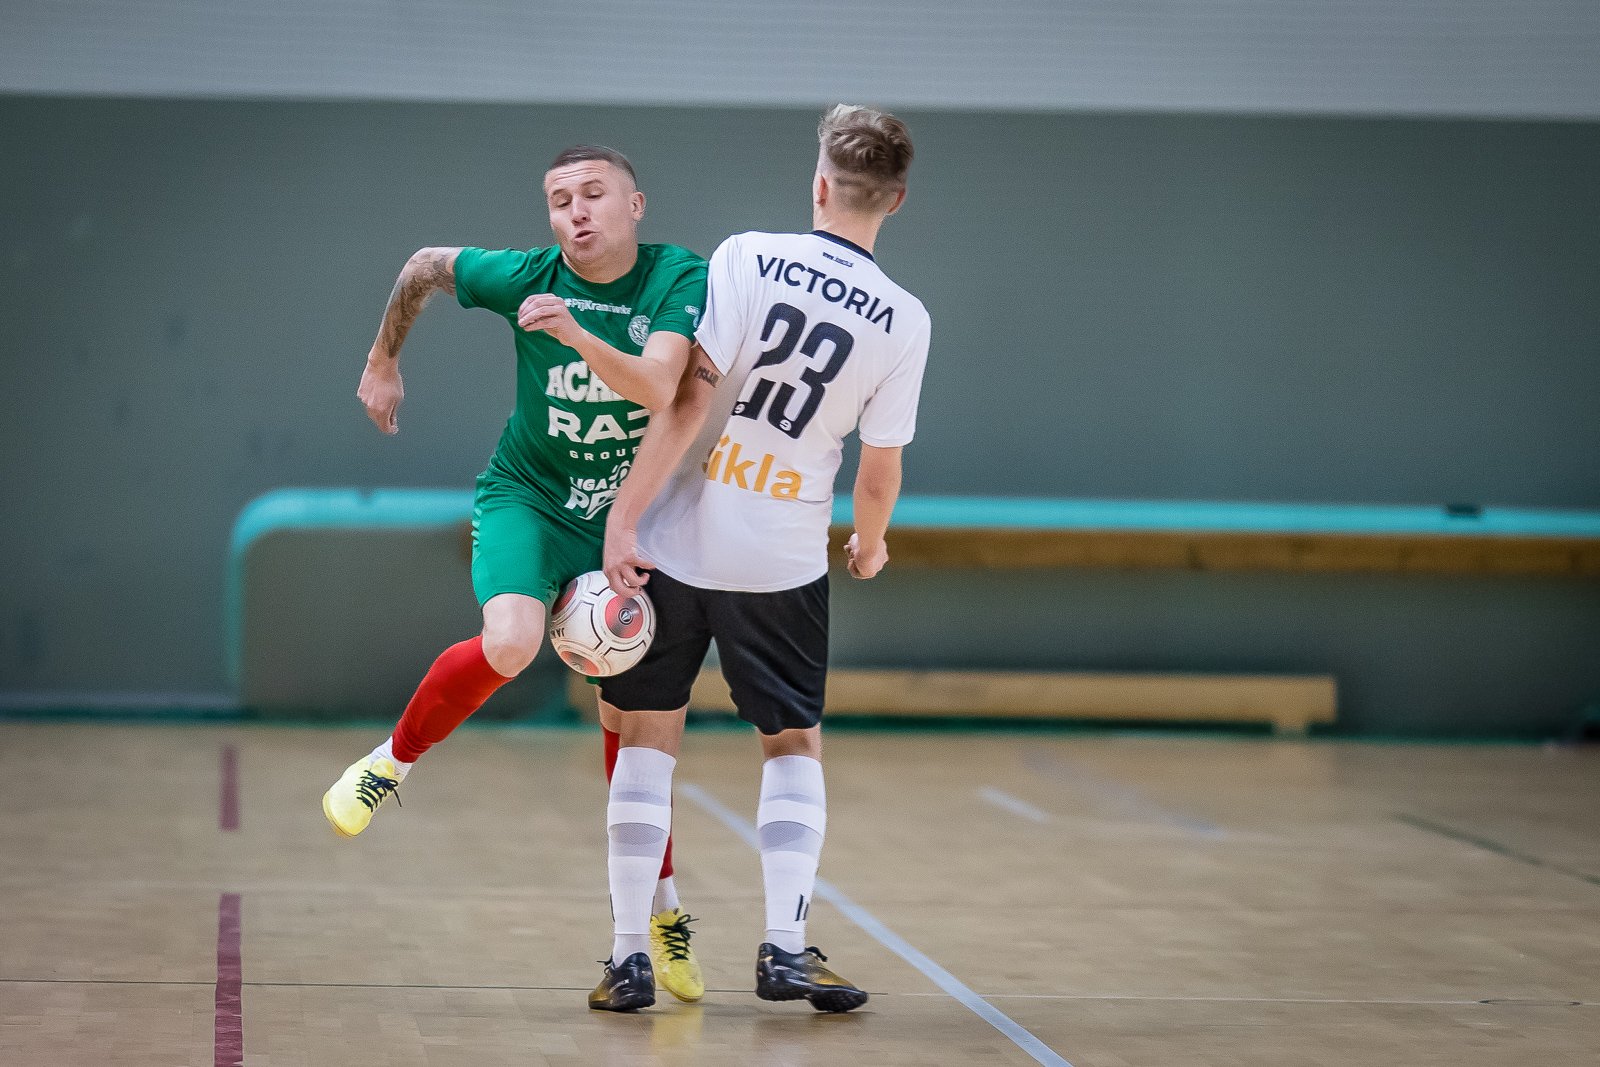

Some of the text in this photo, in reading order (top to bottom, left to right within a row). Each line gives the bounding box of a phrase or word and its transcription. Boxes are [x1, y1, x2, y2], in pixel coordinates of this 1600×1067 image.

[756, 254, 895, 334] VICTORIA
[731, 302, 854, 439] 23
[702, 435, 802, 499] ikla
